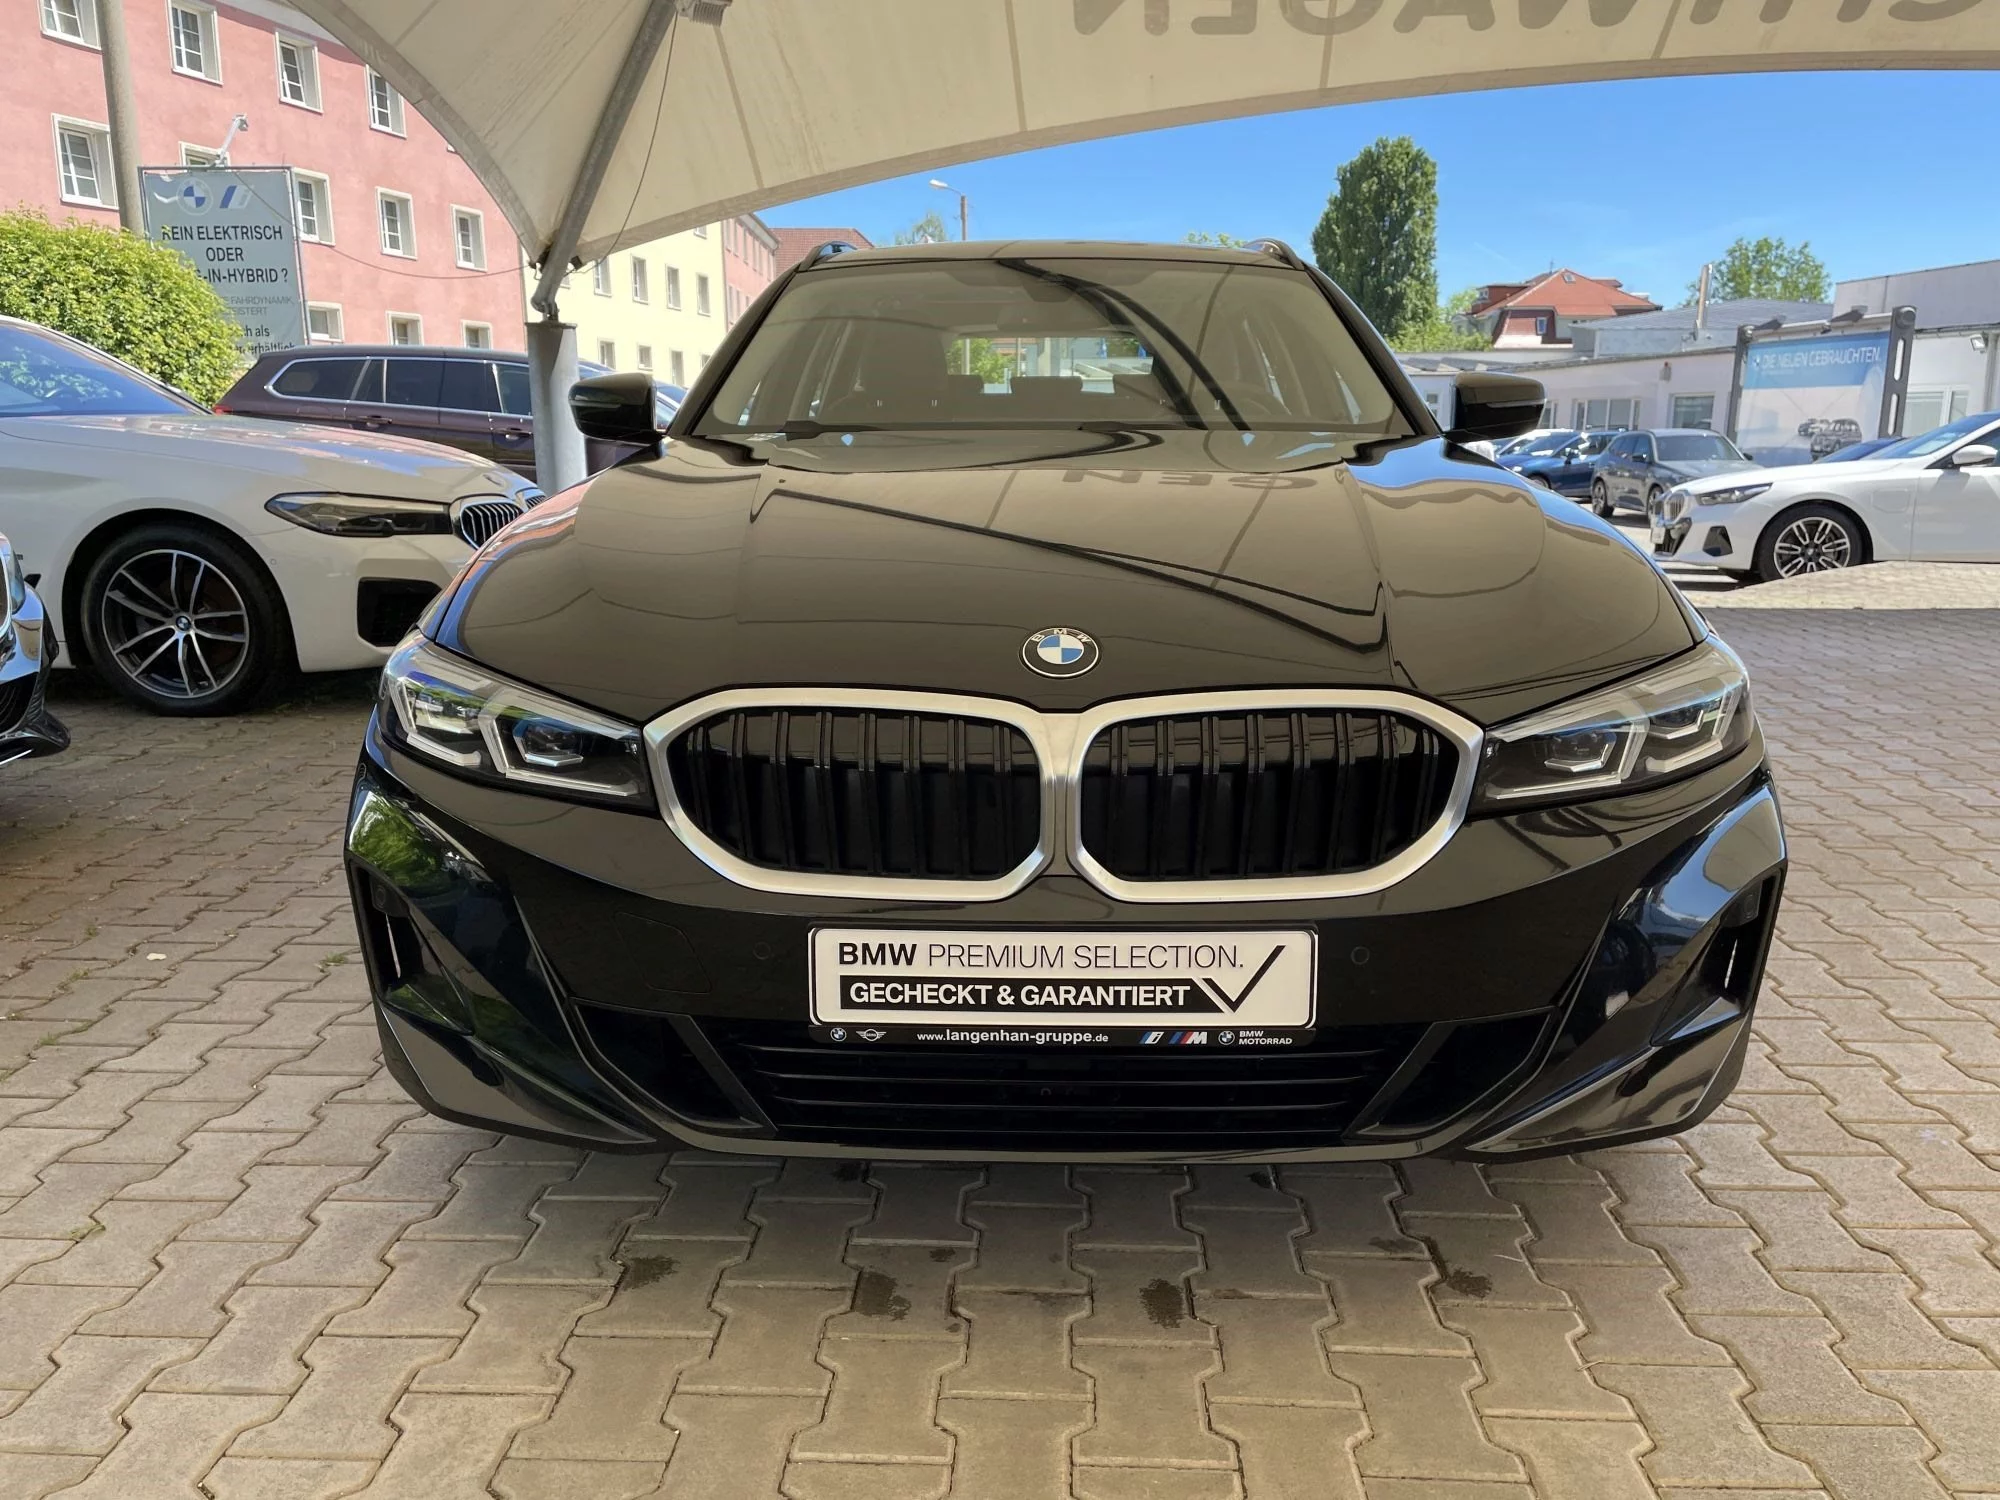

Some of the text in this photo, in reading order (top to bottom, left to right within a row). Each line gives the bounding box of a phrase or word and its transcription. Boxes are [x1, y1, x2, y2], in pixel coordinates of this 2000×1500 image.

[197, 225, 283, 240] ELEKTRISCH
[206, 247, 244, 261] ODER
[255, 324, 270, 337] als
[1031, 627, 1091, 642] BMW
[838, 942, 1244, 969] BMW PREMIUM SELECTION.
[849, 982, 1191, 1006] GECHECKT & GARANTIERT
[916, 1028, 1109, 1044] www.langenhan-gruppe.de
[1238, 1037, 1293, 1045] MOTORRAD
